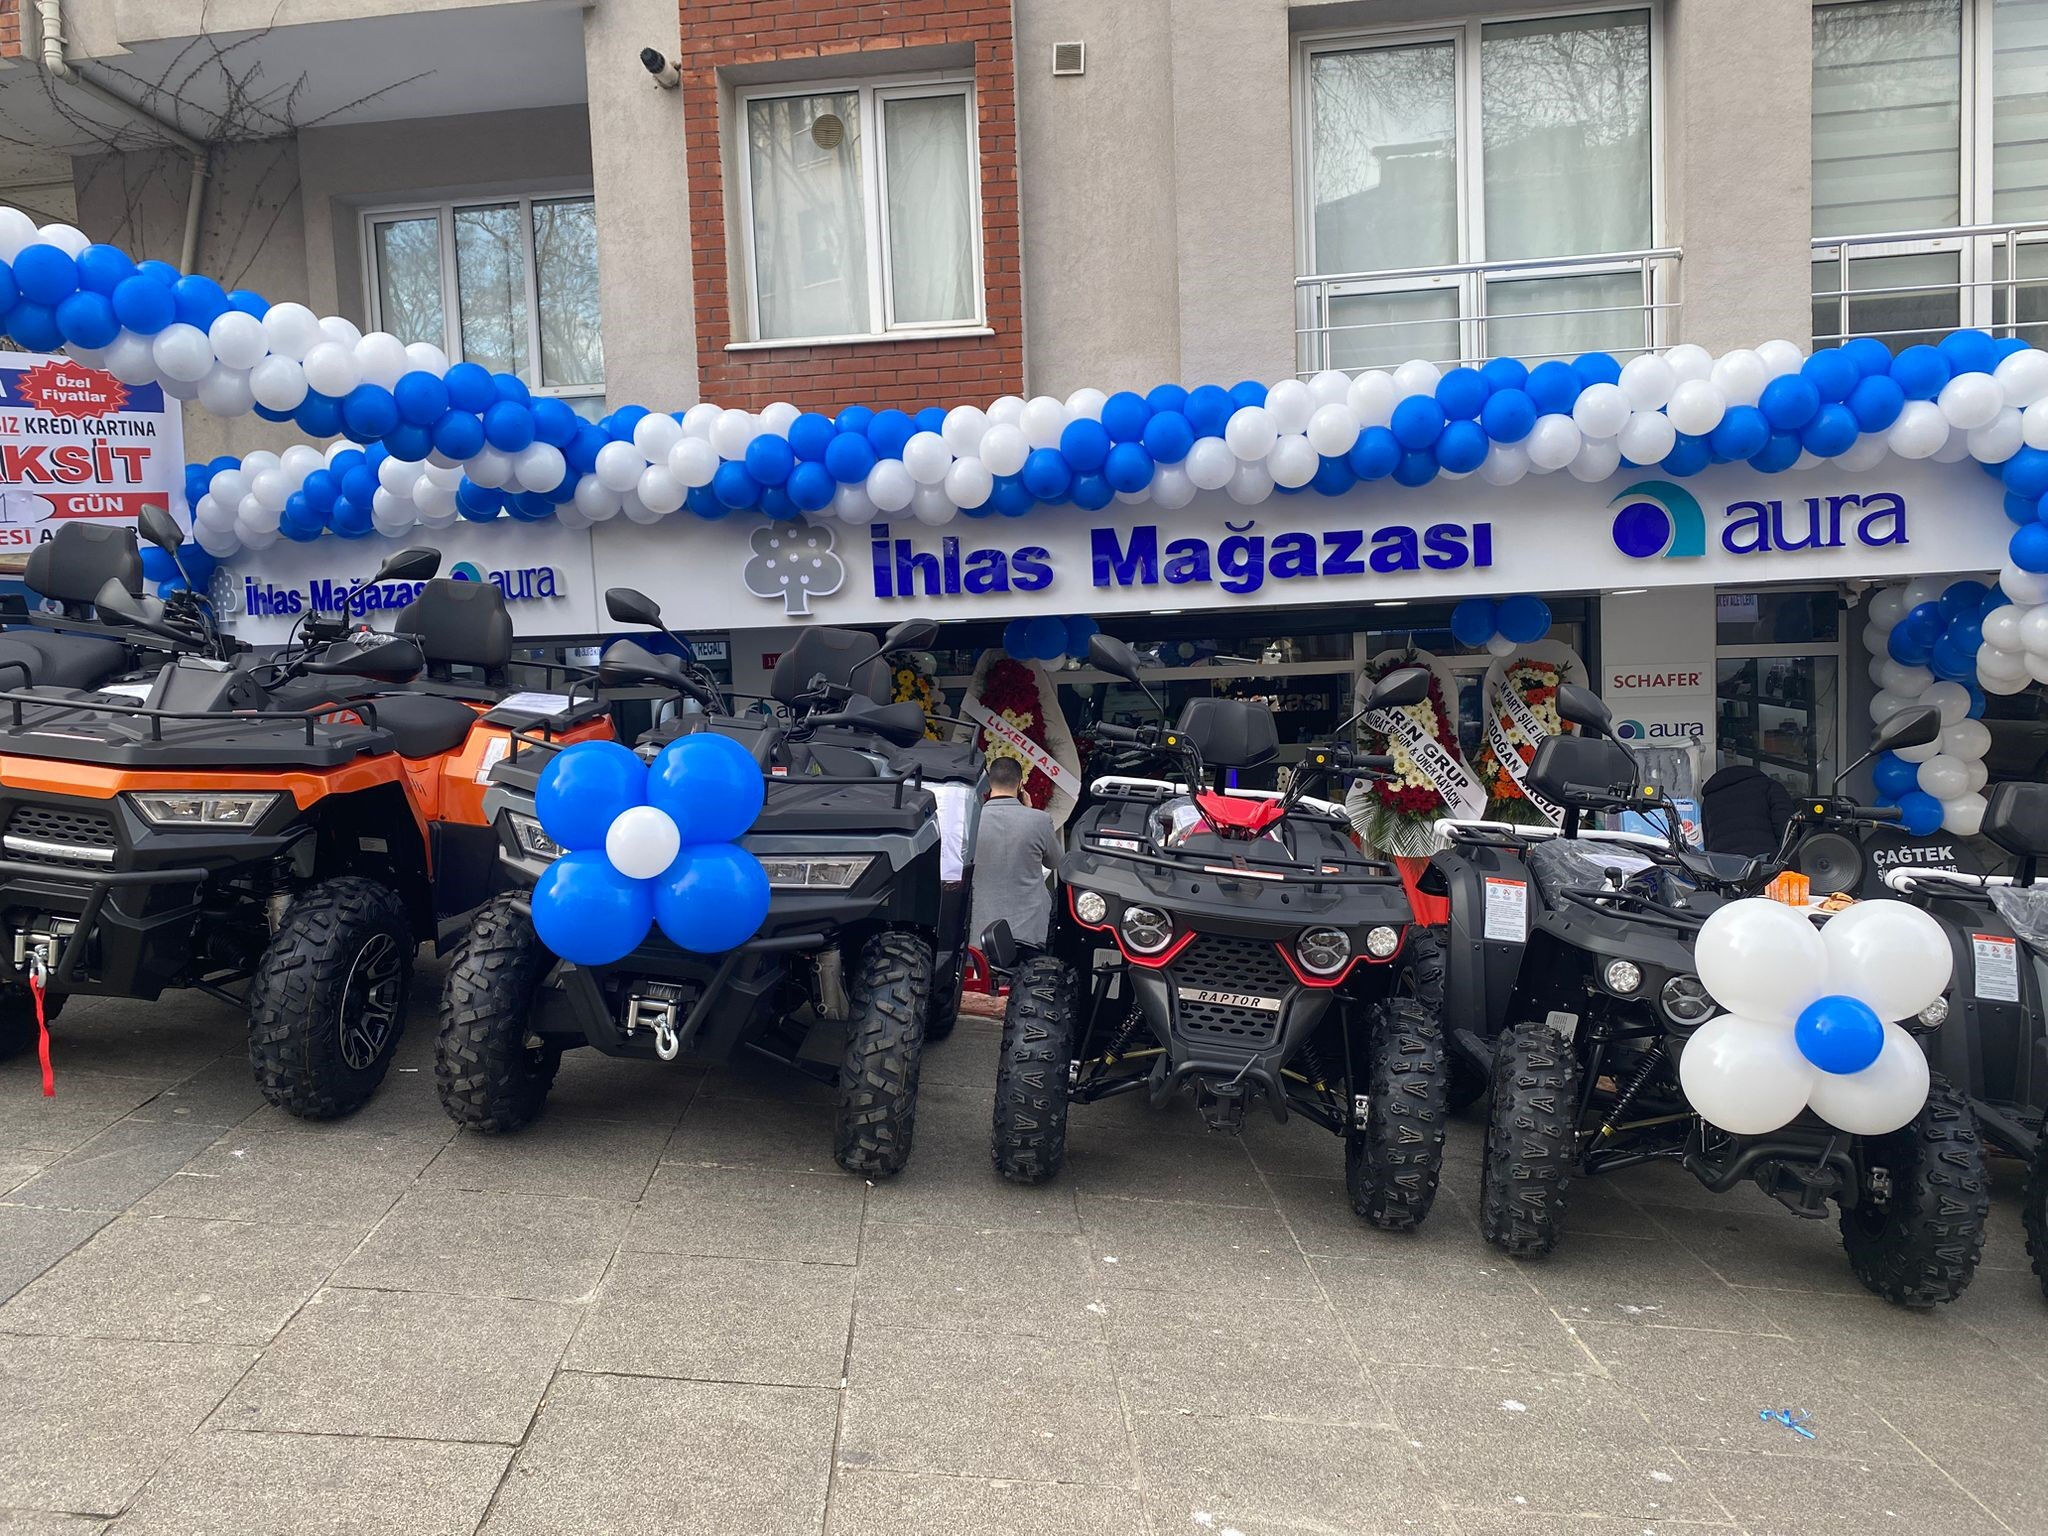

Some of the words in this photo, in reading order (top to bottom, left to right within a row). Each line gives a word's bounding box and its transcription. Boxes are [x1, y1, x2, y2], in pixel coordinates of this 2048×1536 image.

[56, 373, 91, 389] Özel
[42, 389, 107, 404] Fiyatlar
[0, 416, 20, 433] IZ
[84, 418, 156, 437] KARTINA
[0, 438, 151, 483] KSİT
[68, 494, 124, 513] GÜN
[1722, 492, 1910, 555] aura
[870, 523, 1054, 598] İhlas
[1090, 520, 1493, 595] Mağazası
[245, 576, 301, 616] İhlas
[310, 578, 428, 618] Mağazas
[1613, 672, 1699, 689] SCHAFER
[986, 715, 1035, 757] LUXELL
[1648, 722, 1704, 738] aura
[1423, 743, 1470, 789] GRUP
[1873, 845, 1956, 868] ÇAĞTEK
[1198, 991, 1261, 1007] RAPTOR
